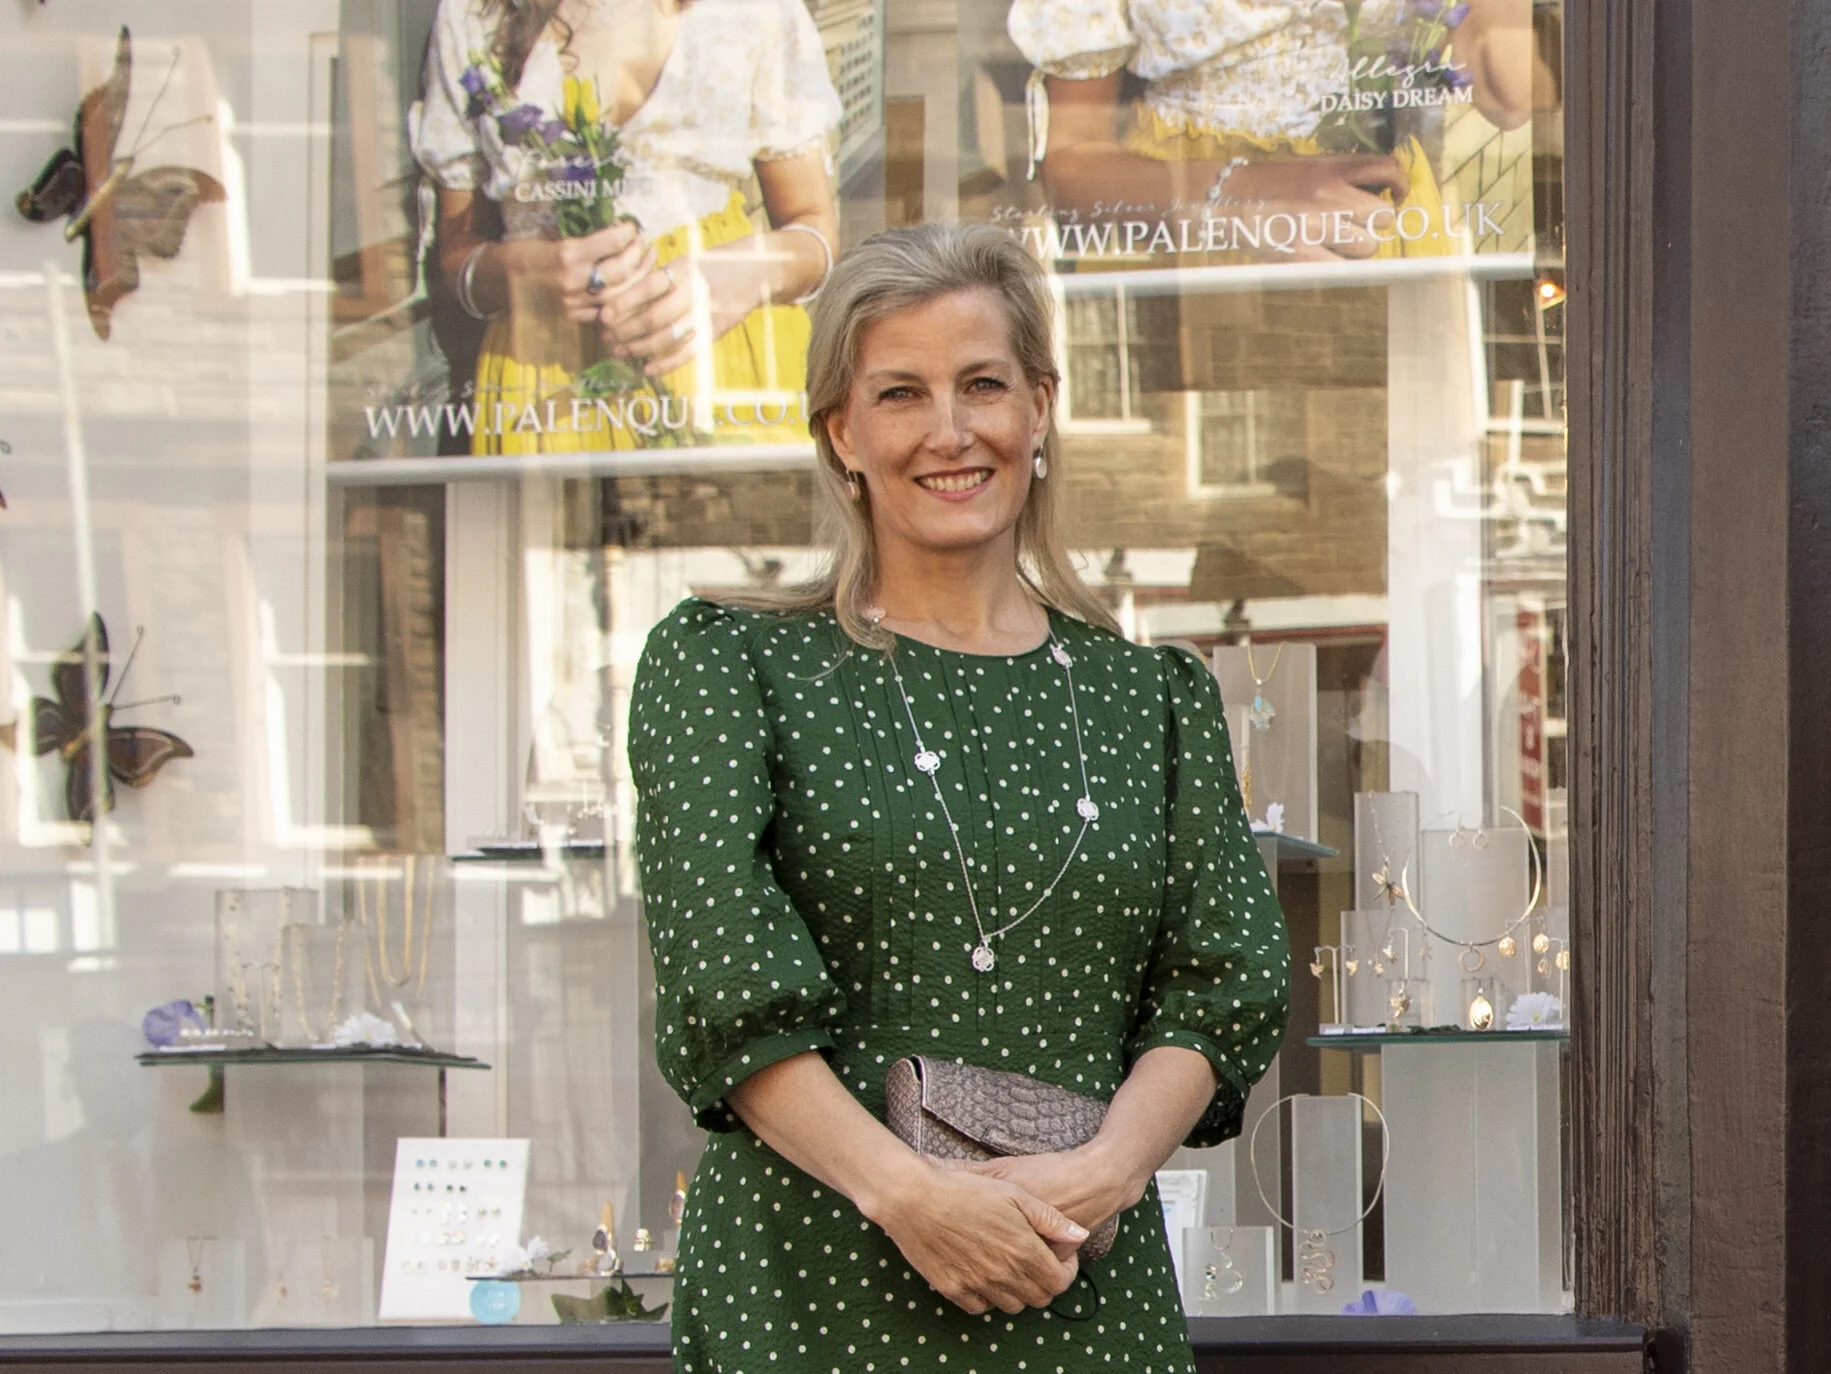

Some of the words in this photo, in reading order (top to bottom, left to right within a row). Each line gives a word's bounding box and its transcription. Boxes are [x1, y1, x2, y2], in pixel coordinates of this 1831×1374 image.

[1321, 89, 1387, 113] DAISY
[1392, 85, 1473, 108] DREAM
[514, 180, 597, 202] CASSINI
